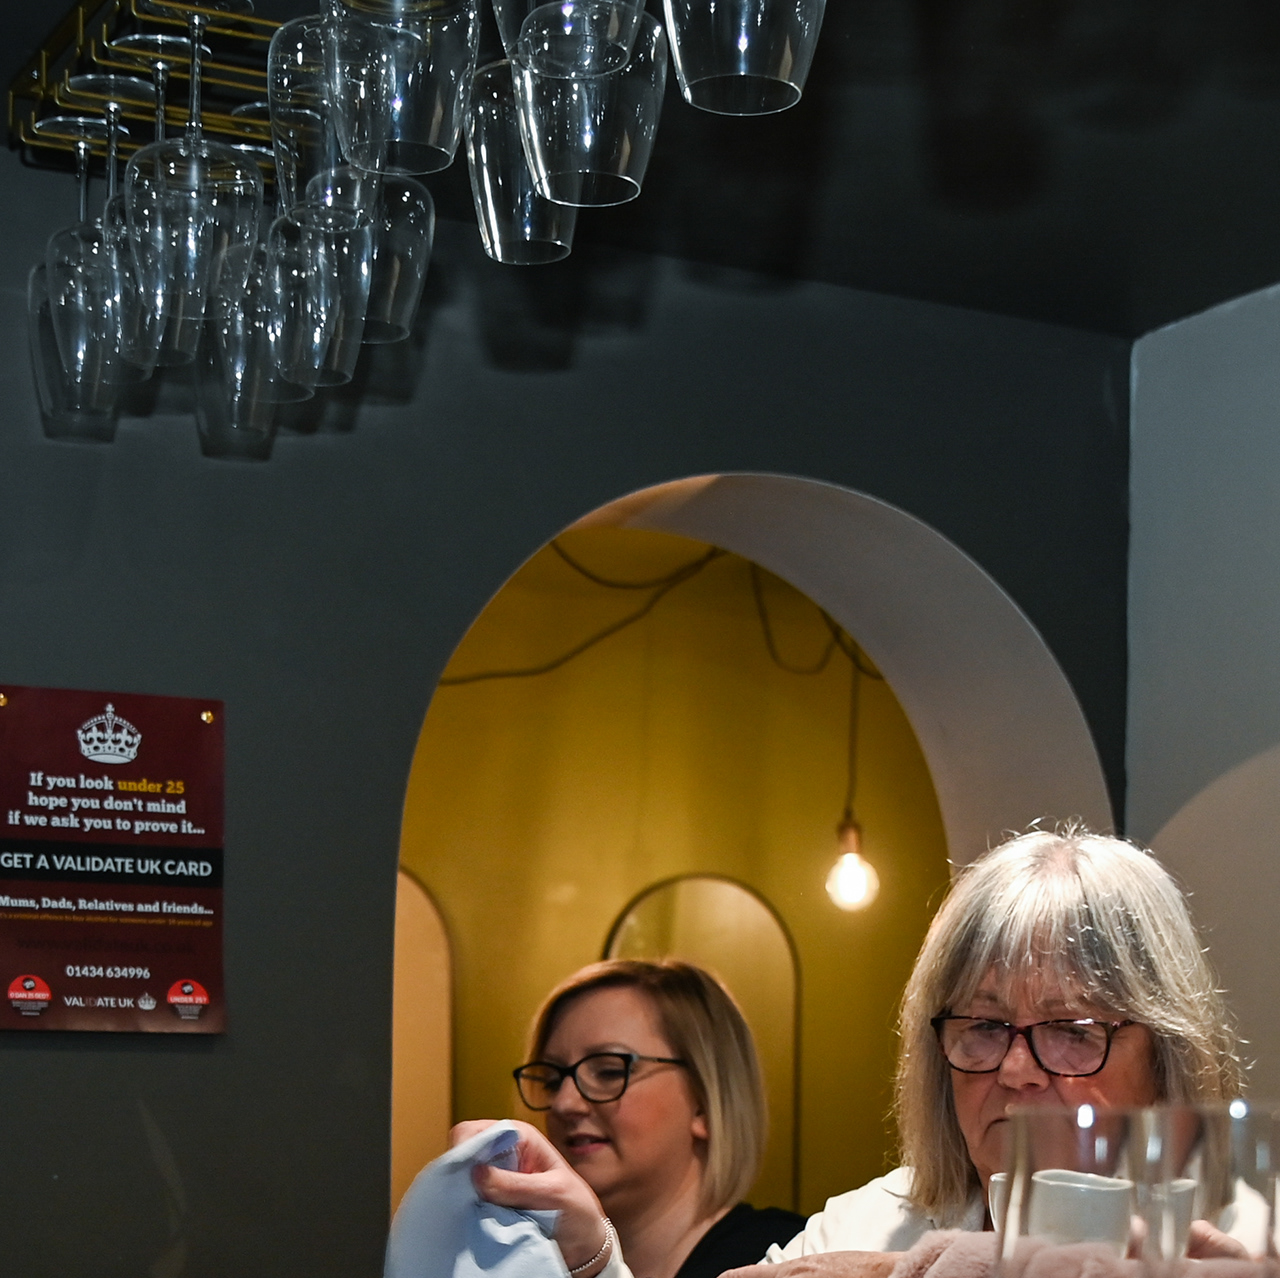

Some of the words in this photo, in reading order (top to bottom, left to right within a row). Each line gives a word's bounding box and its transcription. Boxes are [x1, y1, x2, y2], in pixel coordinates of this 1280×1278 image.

[29, 772, 44, 787] If
[47, 776, 76, 790] you
[79, 774, 114, 791] look
[118, 779, 163, 793] under
[165, 780, 185, 794] 25
[27, 791, 67, 810] hope
[71, 795, 100, 811] you
[104, 796, 144, 812] don't
[147, 798, 187, 814] mind
[8, 810, 21, 825] if
[24, 814, 48, 827] we
[51, 813, 81, 829] ask
[83, 817, 112, 832] you
[116, 817, 131, 831] to
[134, 820, 179, 835] prove
[181, 819, 206, 835] it...
[0, 852, 34, 869] GET
[35, 853, 50, 870] A
[51, 854, 134, 874] VALIDATE
[137, 859, 163, 875] UK
[164, 860, 213, 877] CARD
[41, 897, 77, 912] Dads,
[78, 899, 135, 912] Relatives
[136, 901, 160, 913] and
[162, 901, 214, 915] friends...
[66, 965, 104, 978] 01434
[106, 966, 151, 980] 634996
[64, 996, 117, 1008] VALIDATE
[118, 997, 135, 1008] UK
